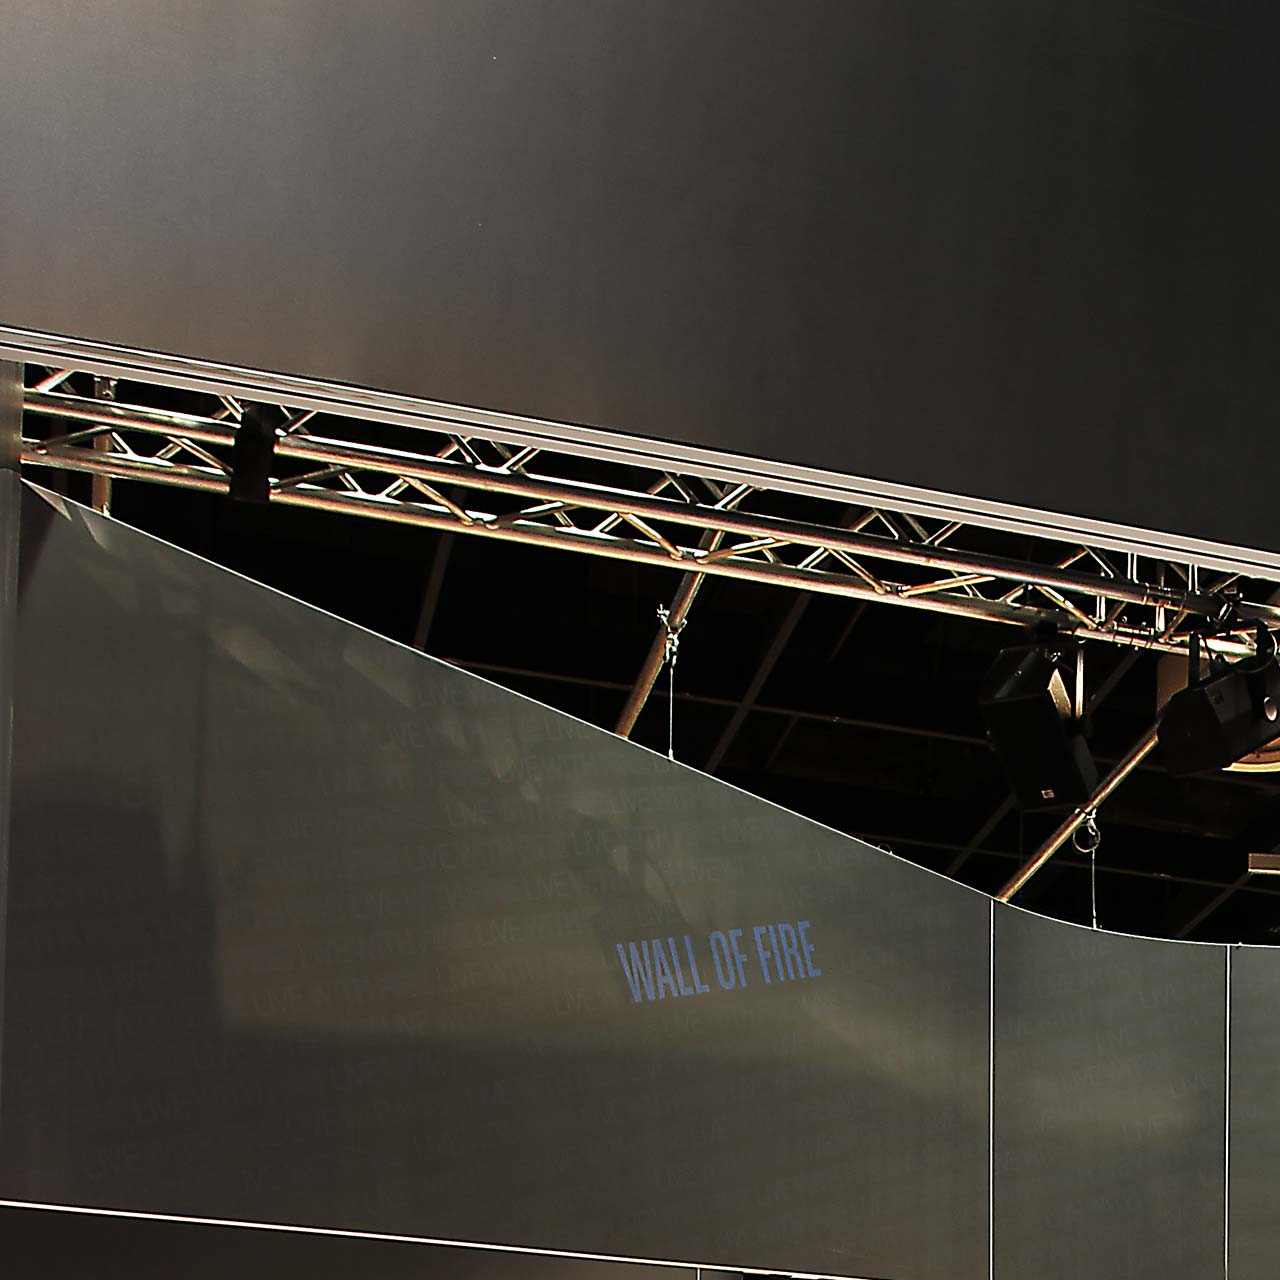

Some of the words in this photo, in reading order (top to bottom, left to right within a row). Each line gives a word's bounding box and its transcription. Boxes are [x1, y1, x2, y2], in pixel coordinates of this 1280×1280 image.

[616, 935, 710, 1003] WALL
[709, 928, 748, 990] OF
[752, 920, 822, 984] FIRE
